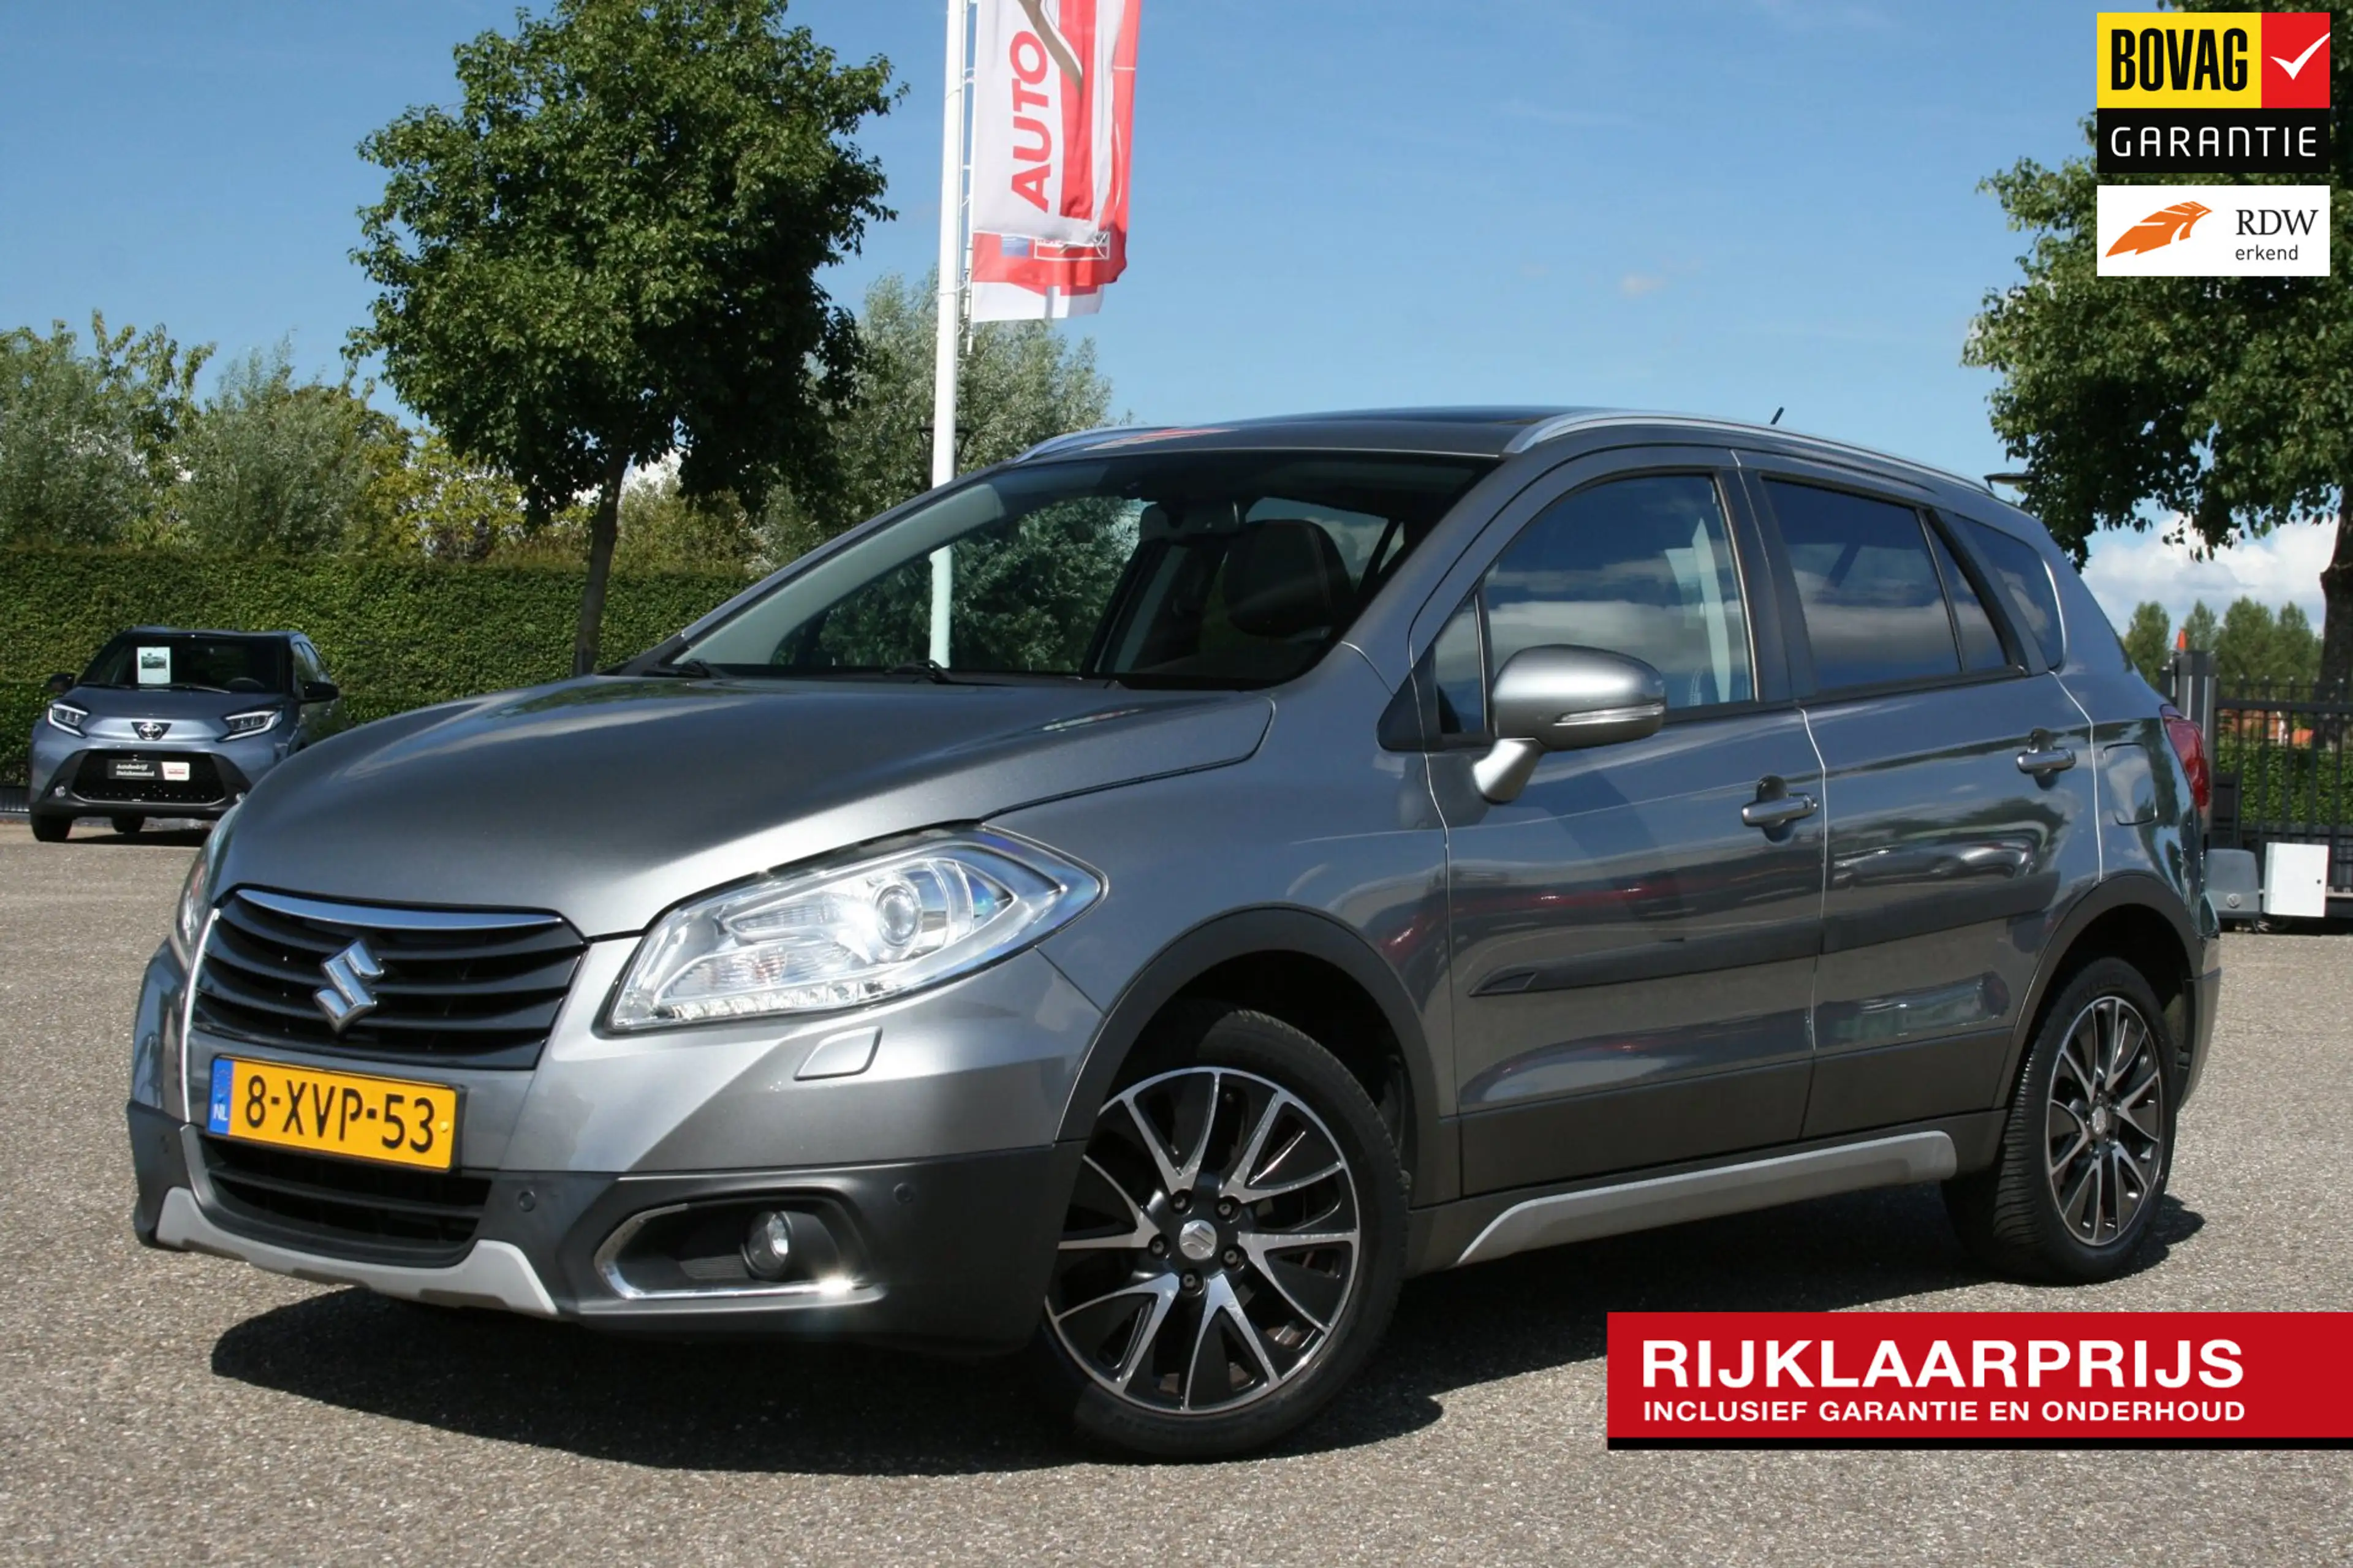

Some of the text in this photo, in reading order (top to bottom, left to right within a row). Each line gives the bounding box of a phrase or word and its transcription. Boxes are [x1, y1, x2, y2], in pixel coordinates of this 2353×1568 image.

[1009, 31, 1052, 213] AUTO
[213, 1103, 229, 1121] NL
[246, 1075, 435, 1153] 8-XVP-53
